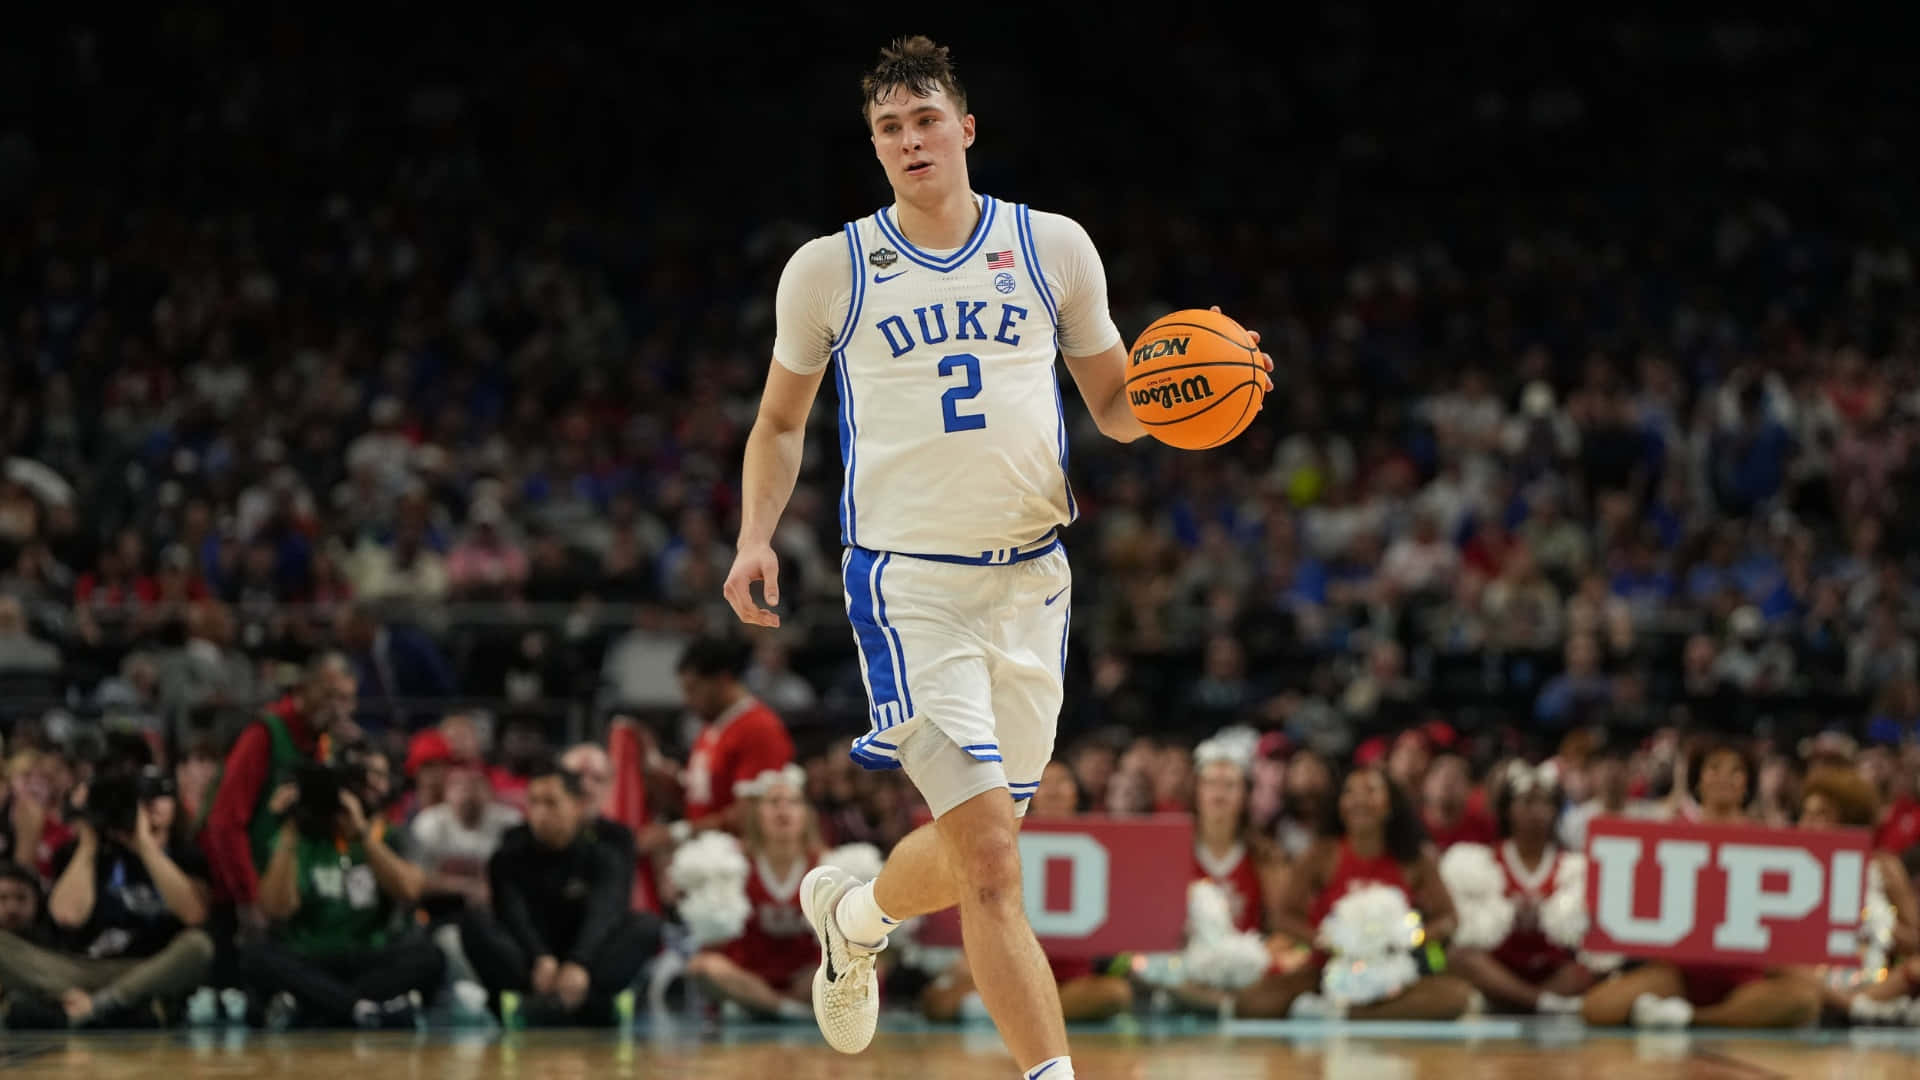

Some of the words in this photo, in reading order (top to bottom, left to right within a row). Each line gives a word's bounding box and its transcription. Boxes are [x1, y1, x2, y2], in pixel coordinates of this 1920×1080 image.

[876, 301, 1028, 358] DUKE
[1133, 337, 1191, 367] NCAA
[938, 353, 986, 433] 2
[1130, 374, 1214, 409] Wilson
[1590, 836, 1863, 956] UP!
